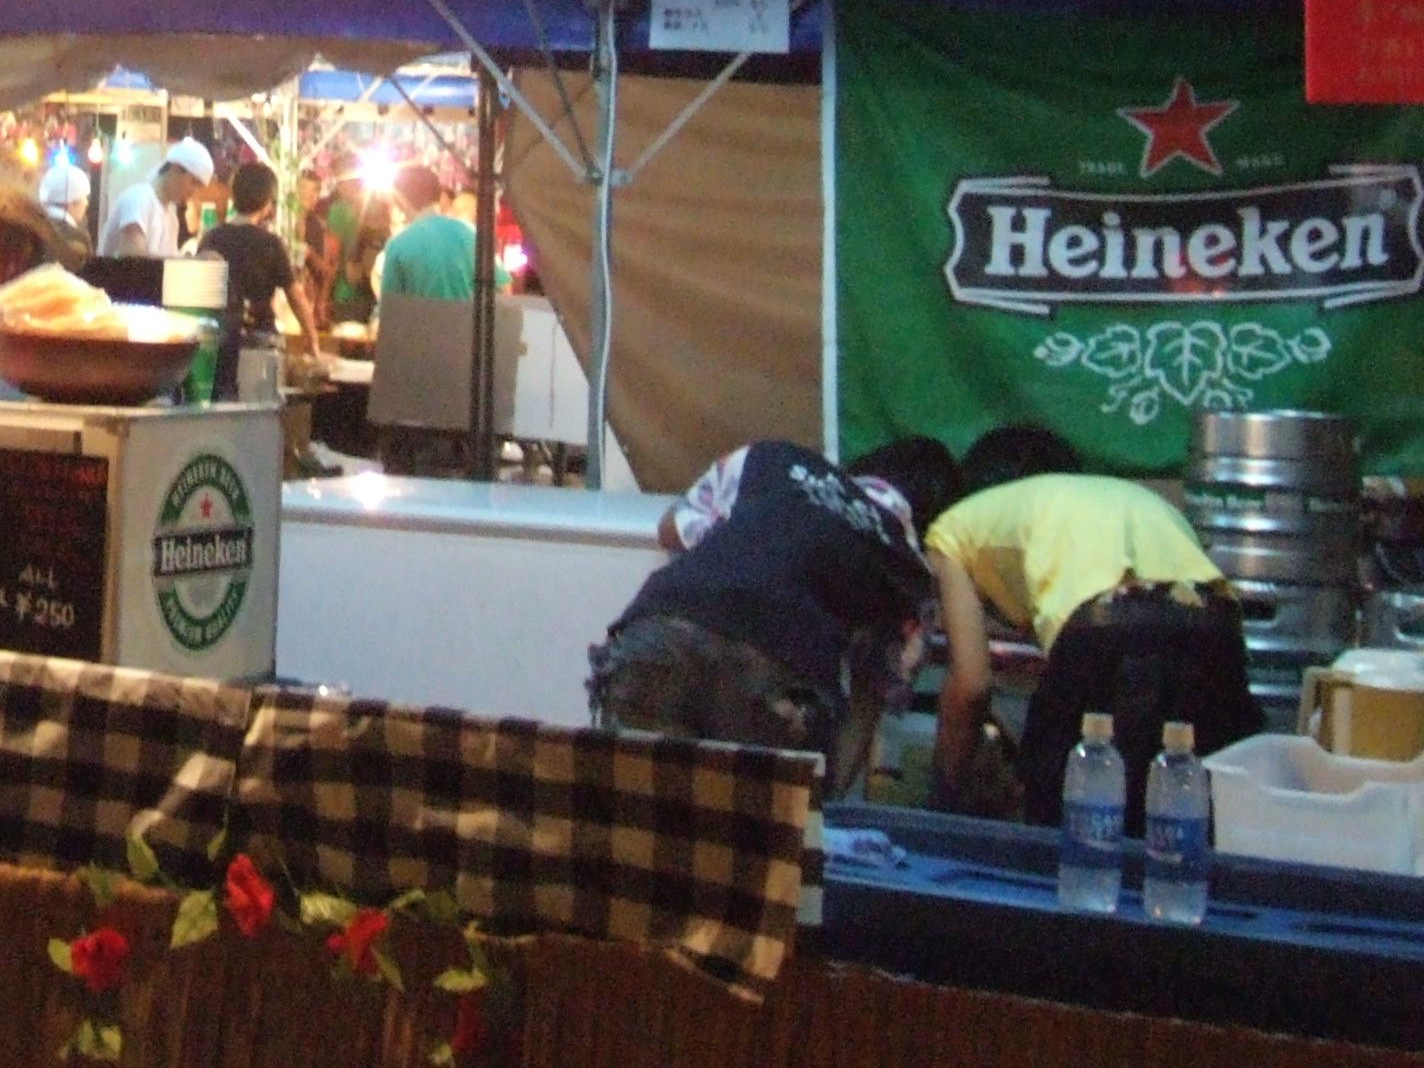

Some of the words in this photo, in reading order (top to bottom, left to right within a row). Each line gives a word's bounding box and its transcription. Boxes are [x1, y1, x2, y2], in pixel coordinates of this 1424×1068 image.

[984, 204, 1391, 279] Heineken
[161, 535, 247, 573] Heineken
[18, 564, 58, 589] ALL
[15, 592, 75, 627] ¥250
